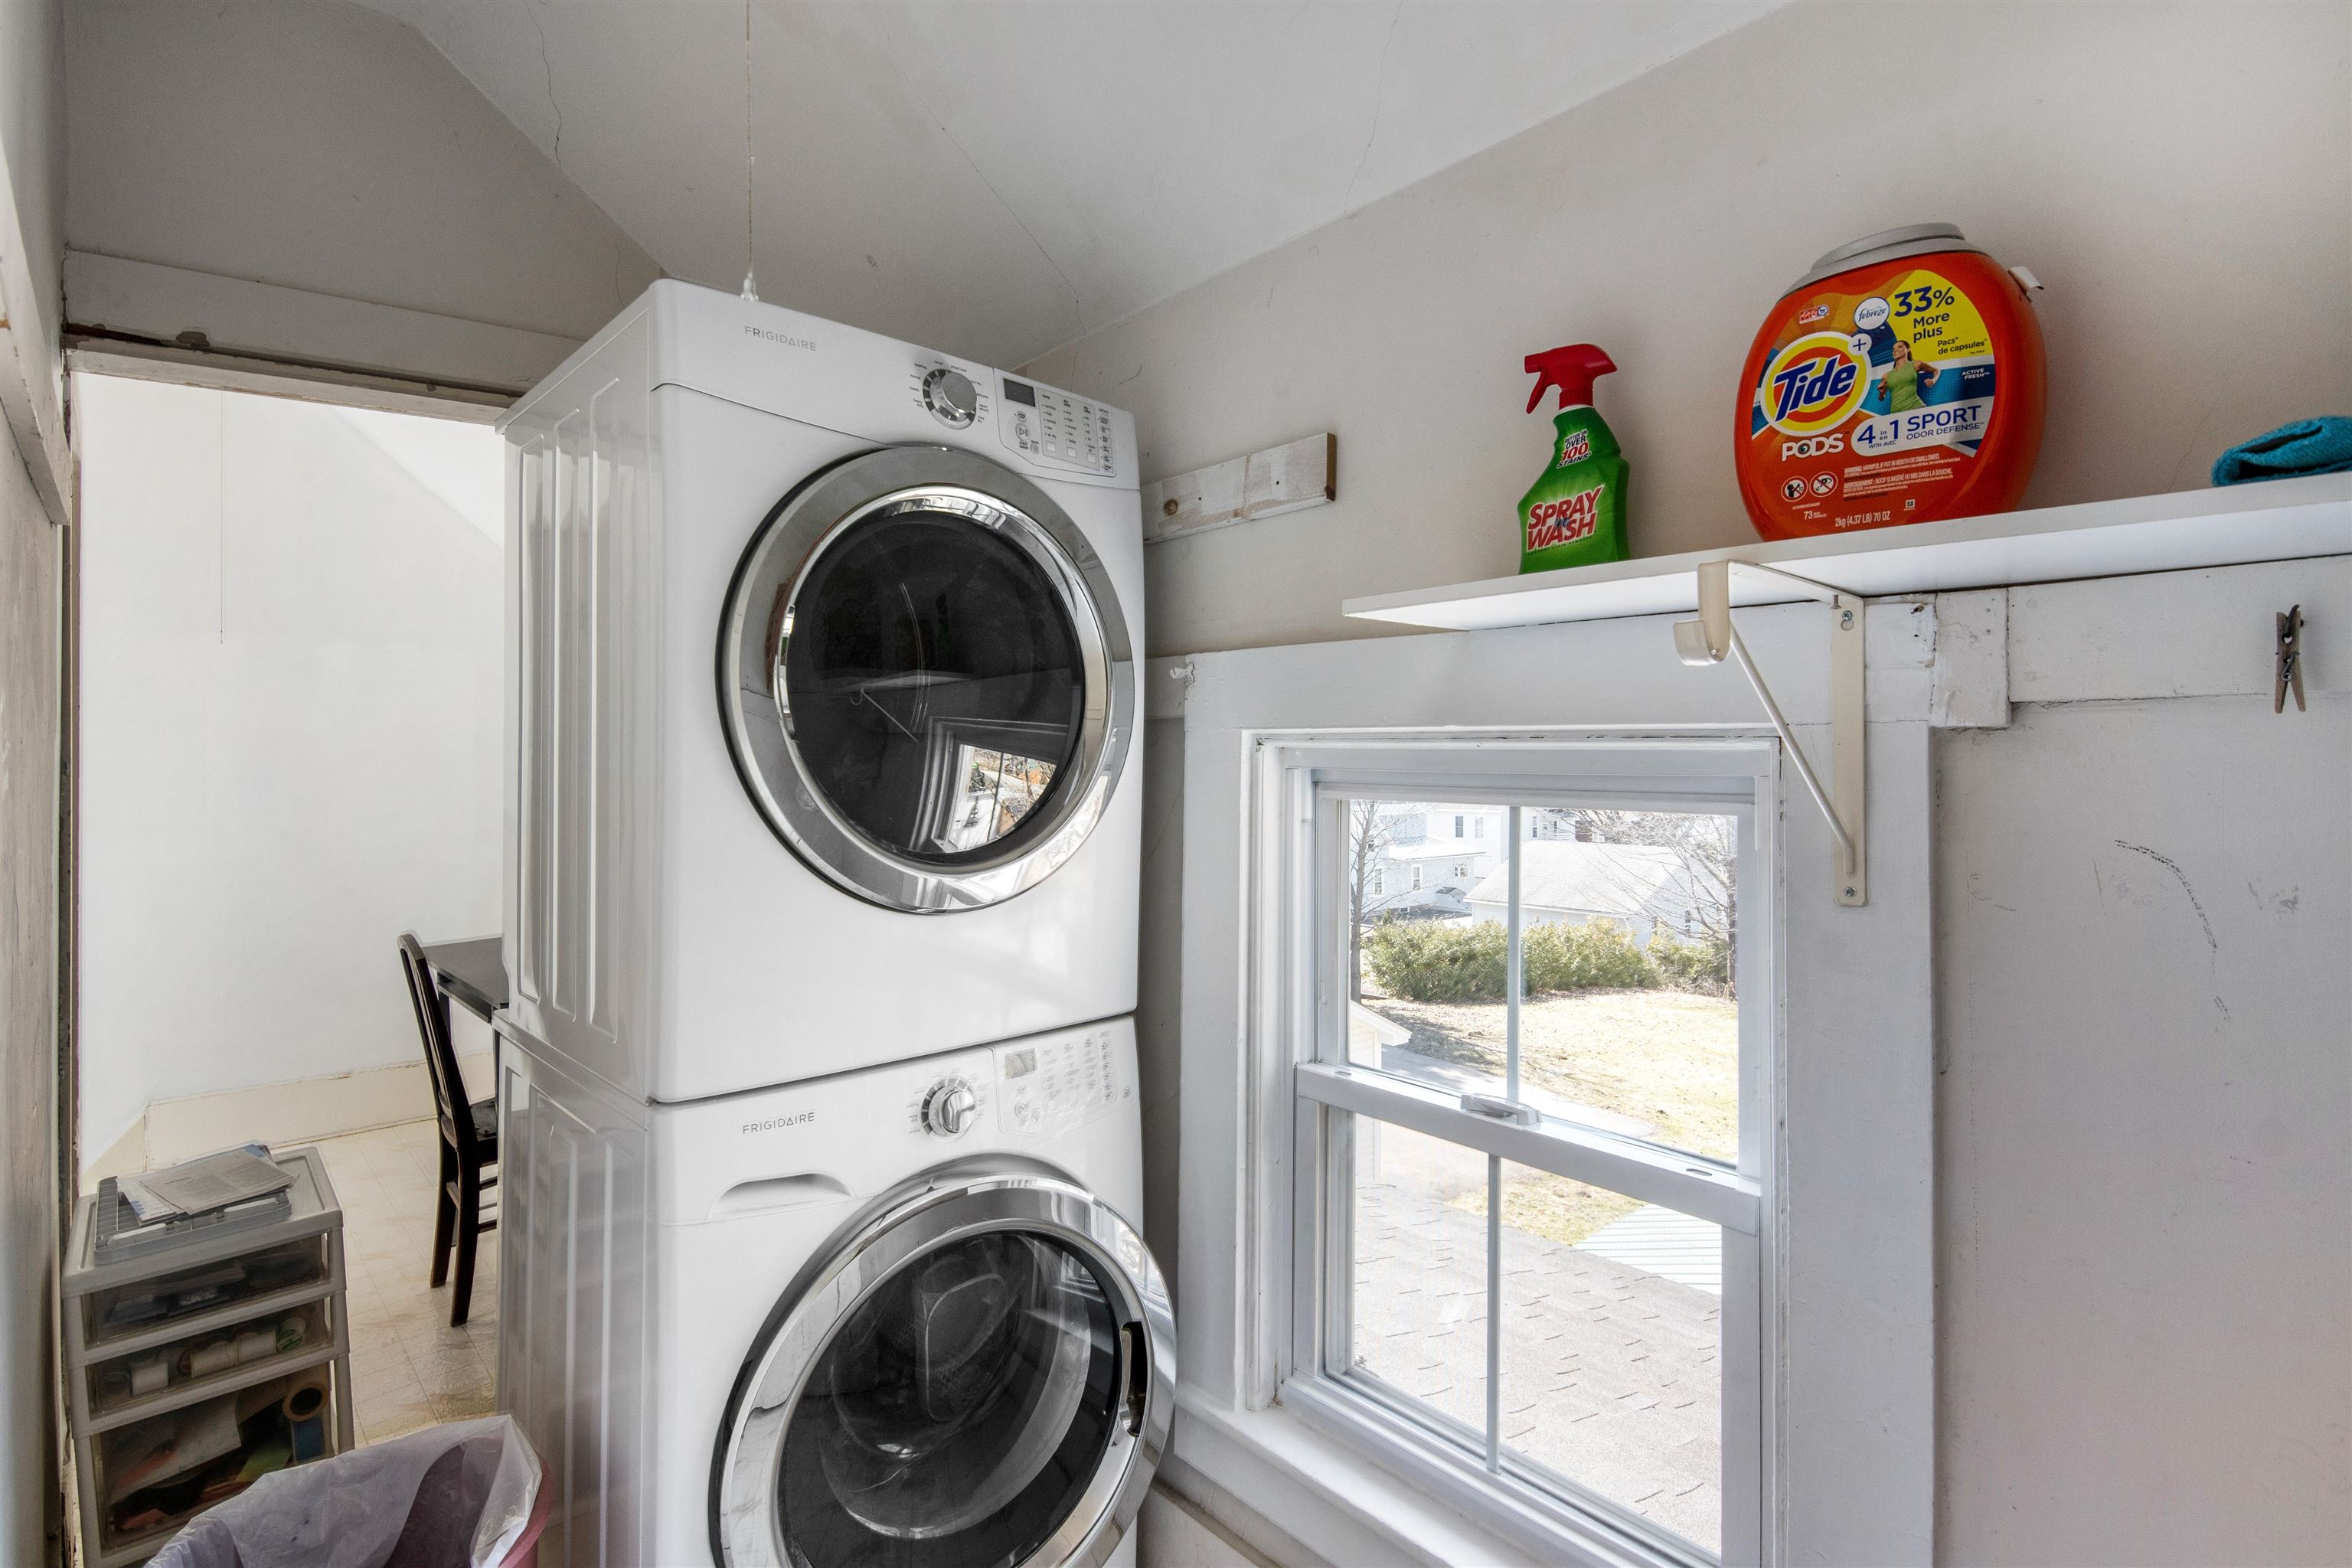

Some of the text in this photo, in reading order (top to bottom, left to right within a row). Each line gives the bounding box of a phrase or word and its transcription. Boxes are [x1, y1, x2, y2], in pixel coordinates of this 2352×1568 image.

[1894, 285, 1955, 317] 33%
[1858, 307, 1886, 322] febreze
[1913, 312, 1950, 328] More
[744, 325, 816, 351] FRIGIDAIRE
[1913, 327, 1943, 343] plus
[1773, 355, 1857, 422] Tide
[1907, 405, 1981, 432] SPORT
[1566, 436, 1586, 449] OVER
[1857, 424, 1876, 444] 4
[1890, 420, 1899, 440] 1
[1906, 430, 1934, 440] ODOR
[1562, 442, 1589, 461] 100
[1782, 433, 1844, 461] PODS
[1528, 486, 1602, 529] SPRAY
[1804, 511, 1813, 520] 73
[1527, 511, 1596, 550] WASH
[1834, 511, 1890, 528] 2kg (4.37 LB) 70 OZ
[743, 1112, 815, 1134] FRIGIDAIRE
